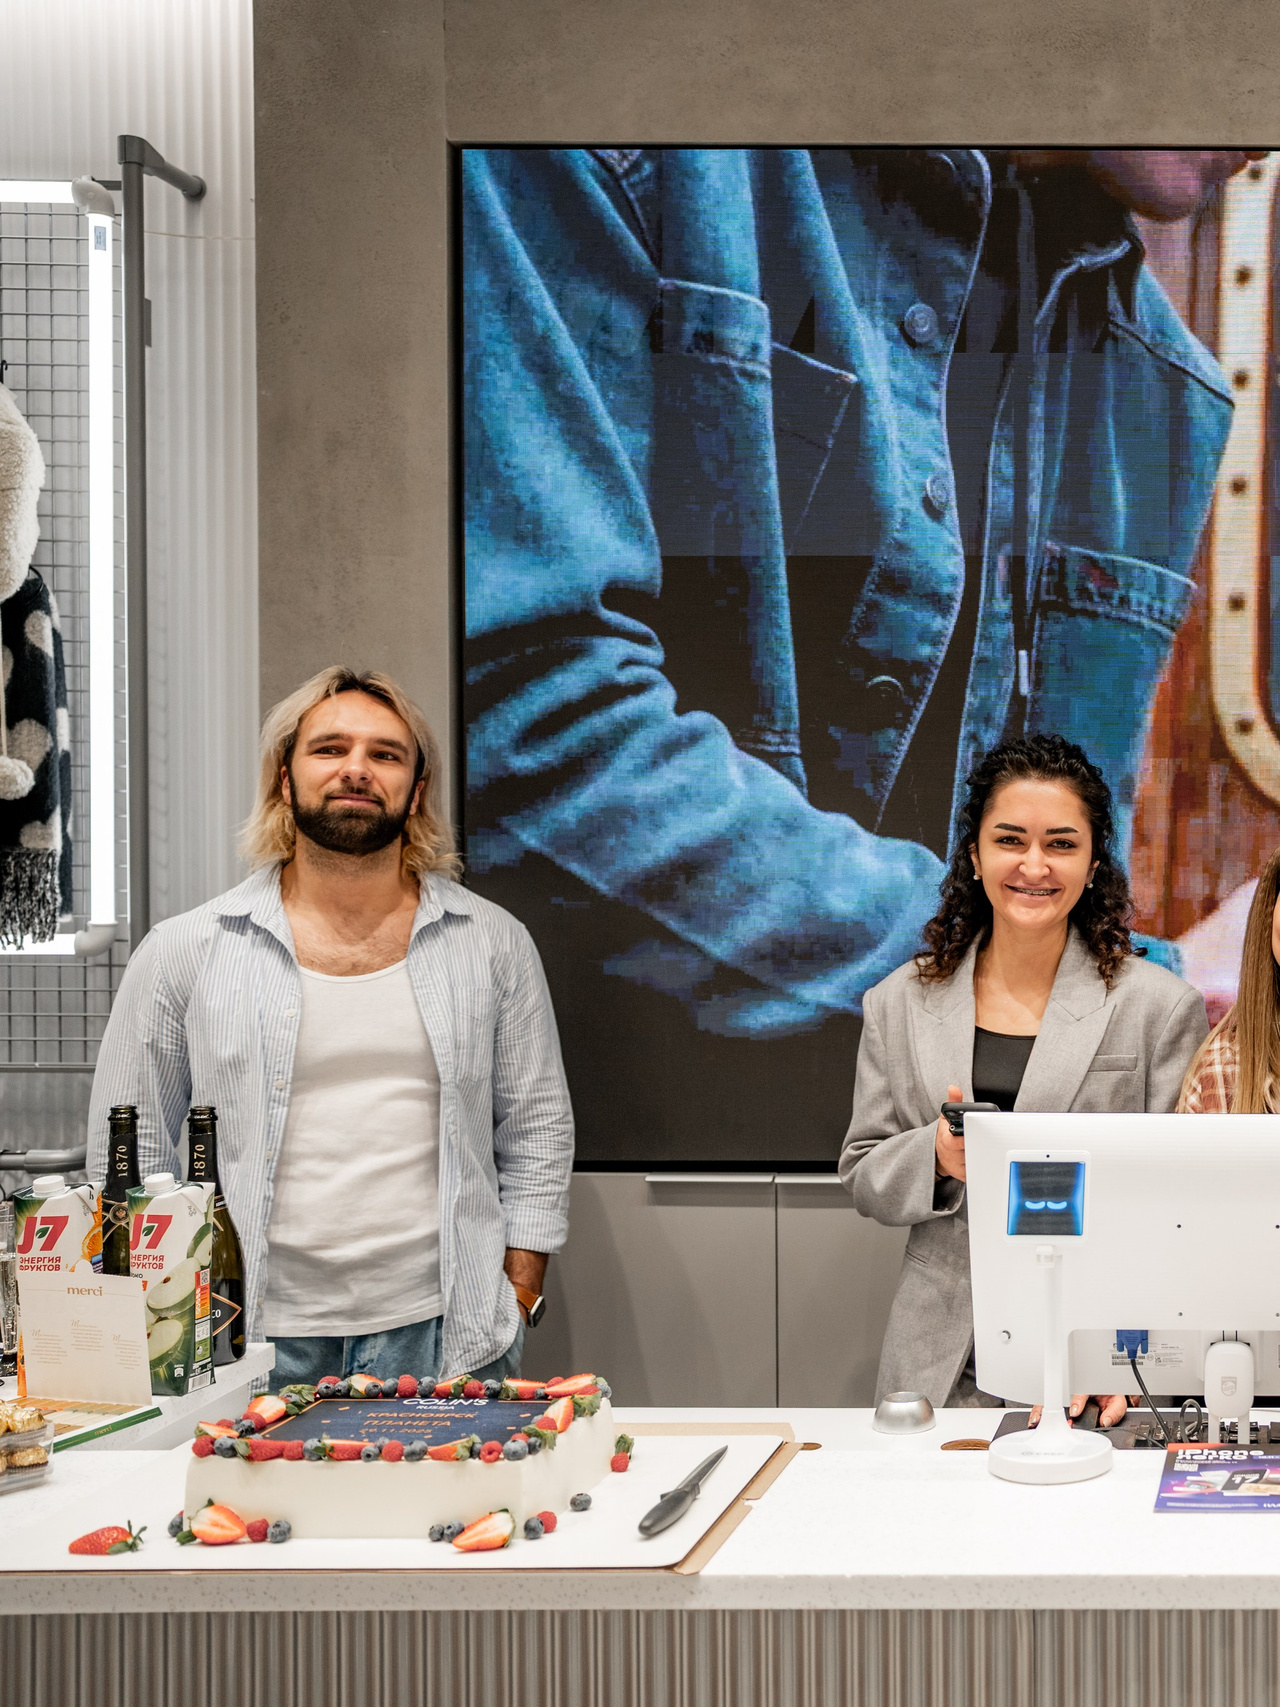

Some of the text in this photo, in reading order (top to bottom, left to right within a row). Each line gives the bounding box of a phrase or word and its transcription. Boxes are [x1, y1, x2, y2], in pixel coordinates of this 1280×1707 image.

[115, 1145, 129, 1178] 1870
[193, 1144, 206, 1177] 1870
[19, 1256, 61, 1265] ЭНЕРГИЯ
[67, 1286, 103, 1296] merci
[402, 1398, 489, 1406] COLIN'S
[1231, 1476, 1257, 1484] 17
